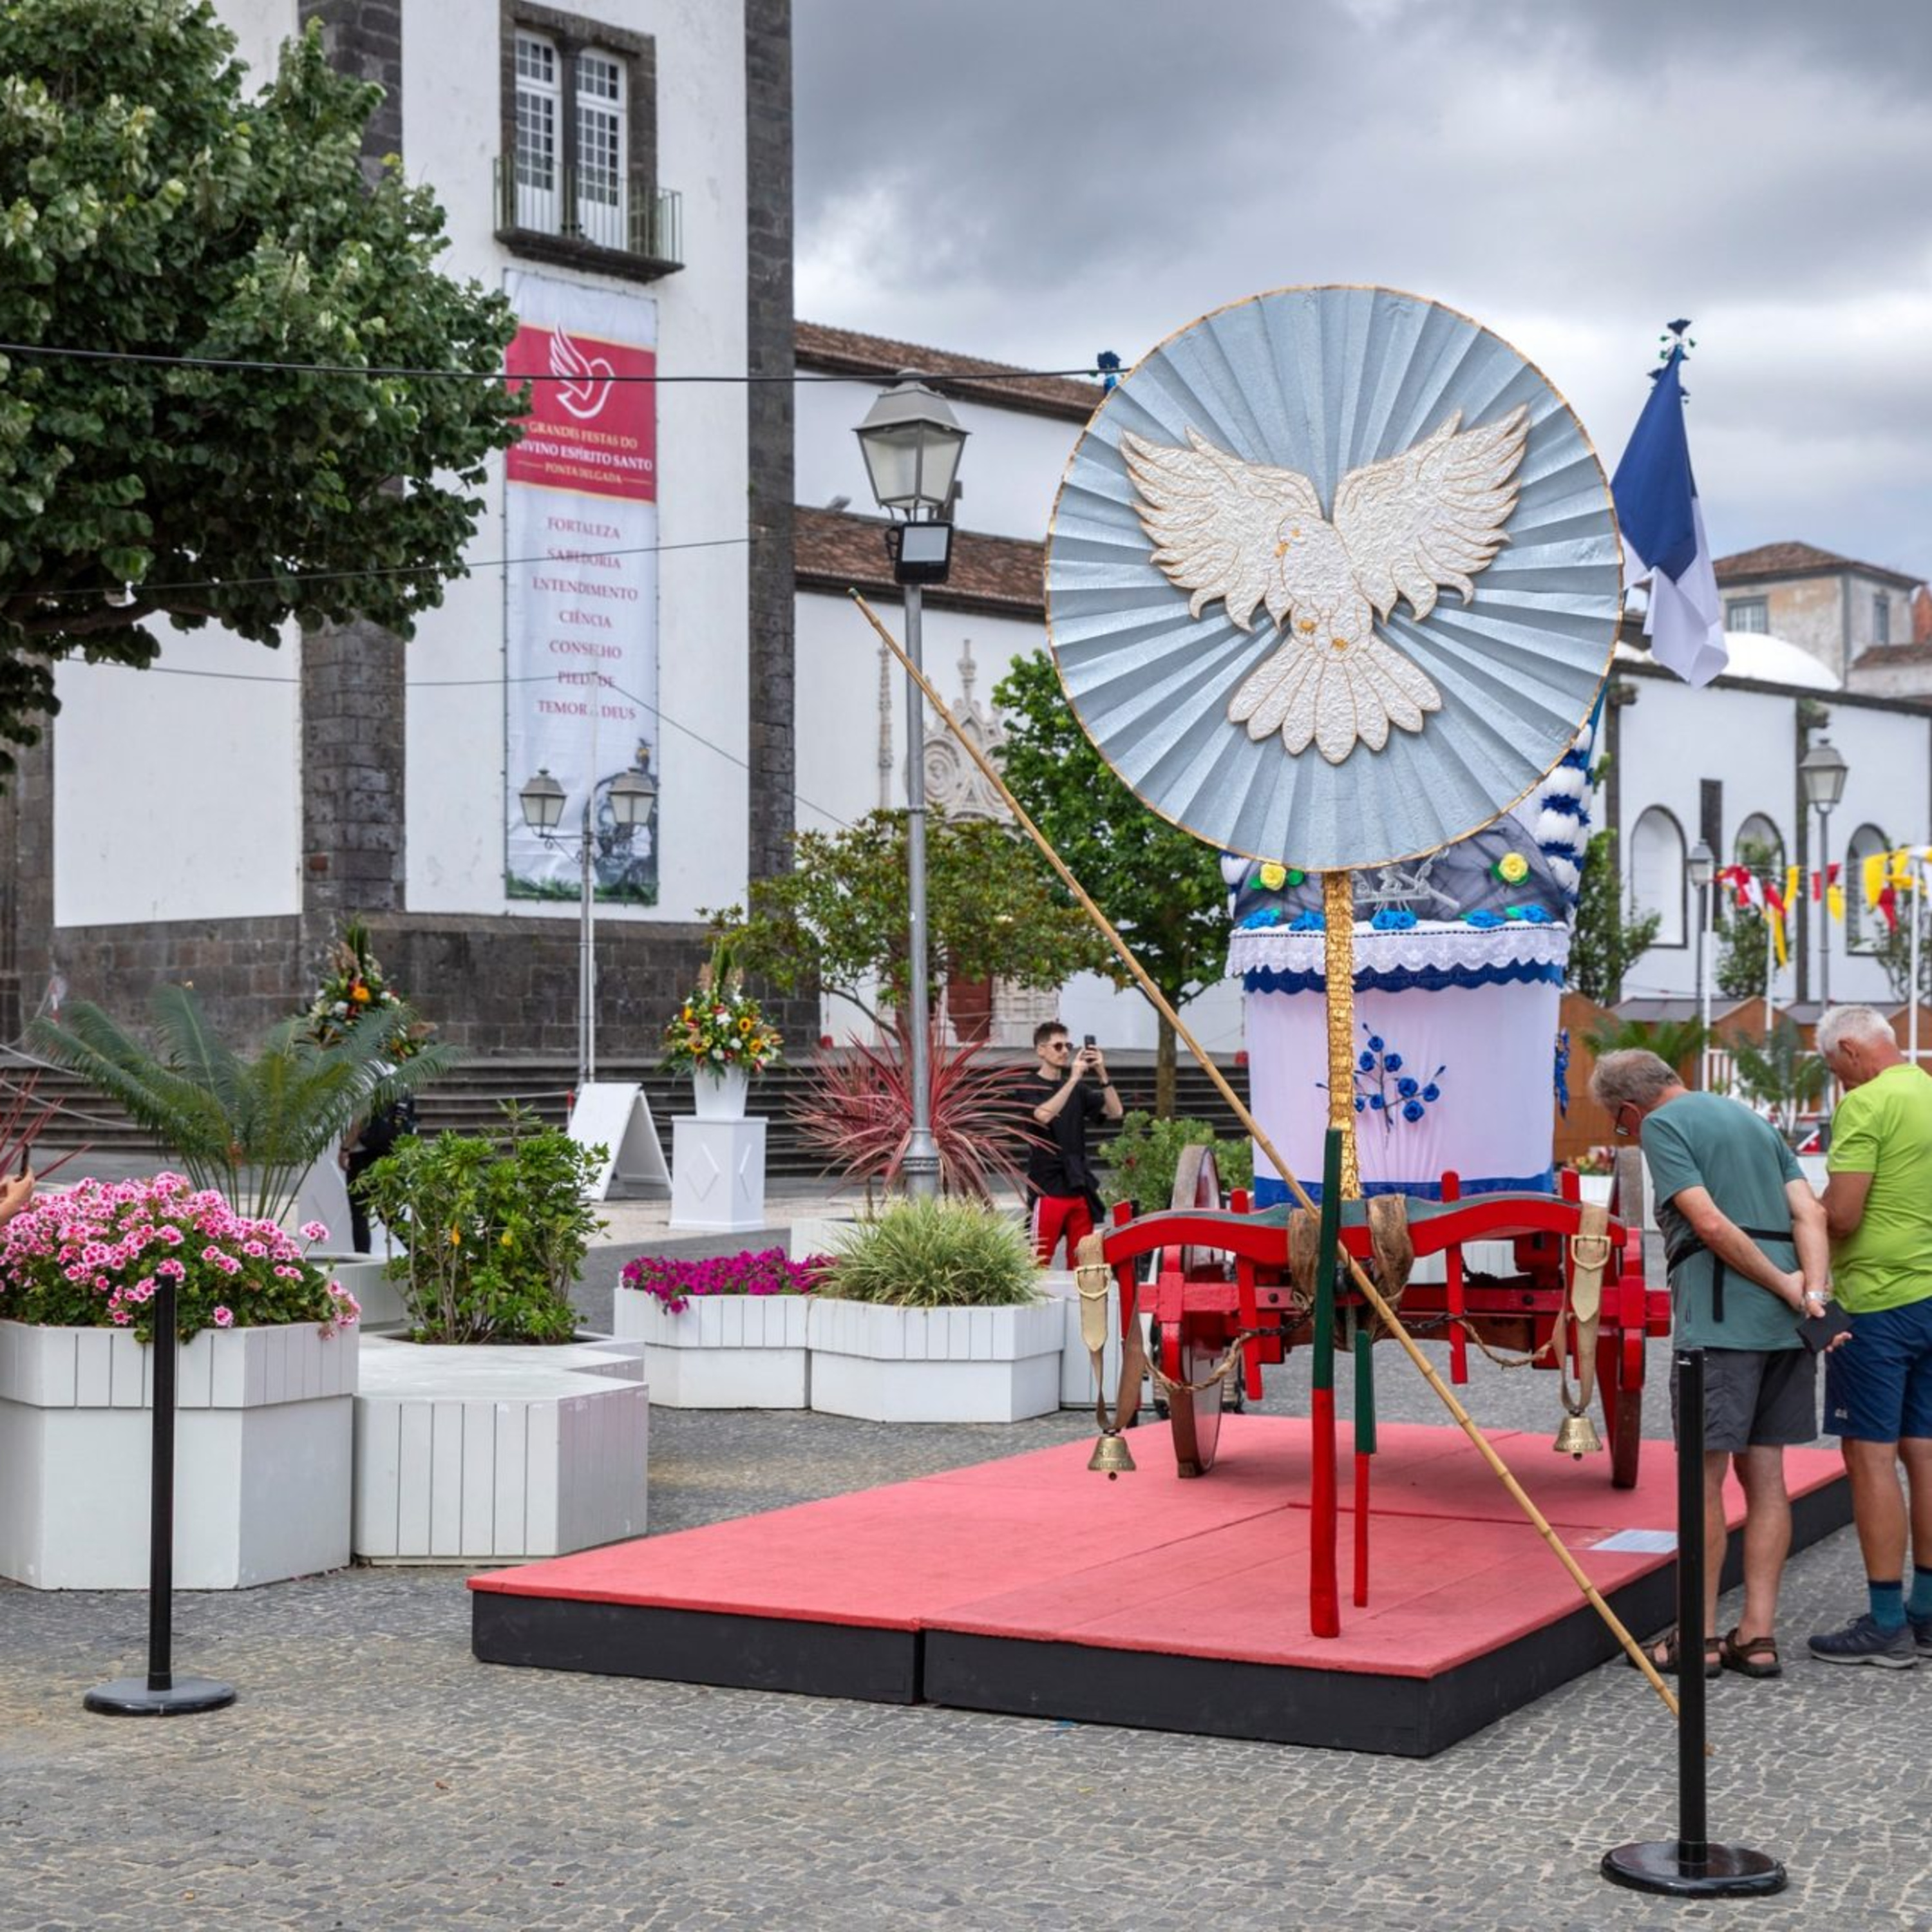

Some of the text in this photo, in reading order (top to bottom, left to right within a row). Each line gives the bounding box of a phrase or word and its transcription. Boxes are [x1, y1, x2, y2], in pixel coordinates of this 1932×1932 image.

[528, 421, 638, 449] GRANDES FESTAS DO
[560, 444, 611, 465] ESPÍRITO
[611, 455, 652, 471] SANTO
[545, 461, 623, 484] PONTA DELGADA
[547, 516, 620, 540] FORTALEZA
[533, 576, 638, 601] ENTENDIMENTO
[559, 609, 612, 629] CIÊNCIA
[549, 639, 622, 659] CONSELHO
[558, 670, 614, 688] PIEDDE
[538, 699, 587, 716] TEMOR
[601, 705, 636, 721] DEUS
